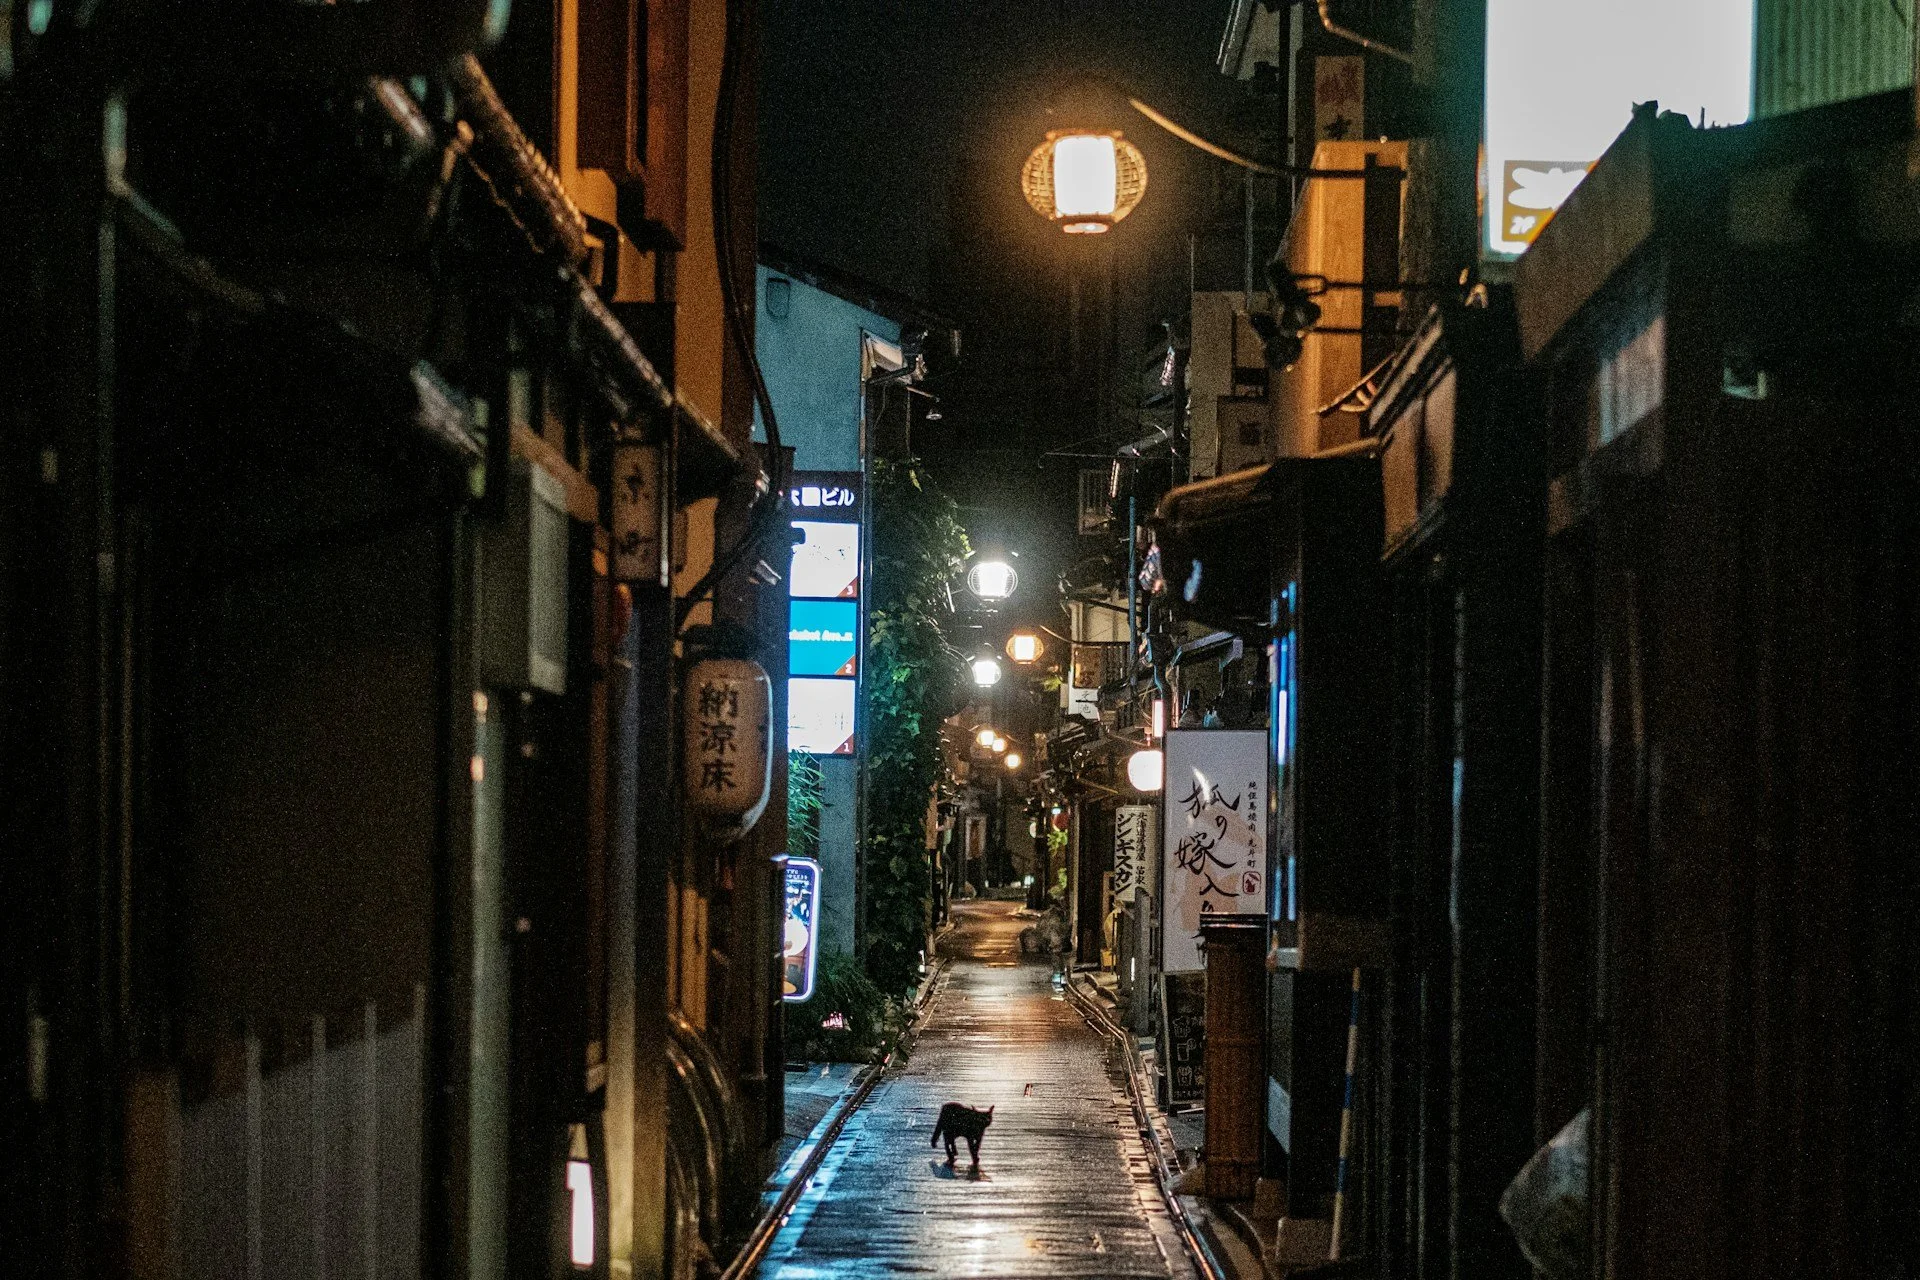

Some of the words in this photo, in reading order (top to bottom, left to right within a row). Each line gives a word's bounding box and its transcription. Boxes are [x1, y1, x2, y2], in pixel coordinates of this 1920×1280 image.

[846, 585, 854, 595] 3
[844, 663, 853, 674] 2
[699, 680, 738, 792] 納涼床
[843, 742, 851, 752] 1
[1115, 813, 1136, 895] ジンギスカン
